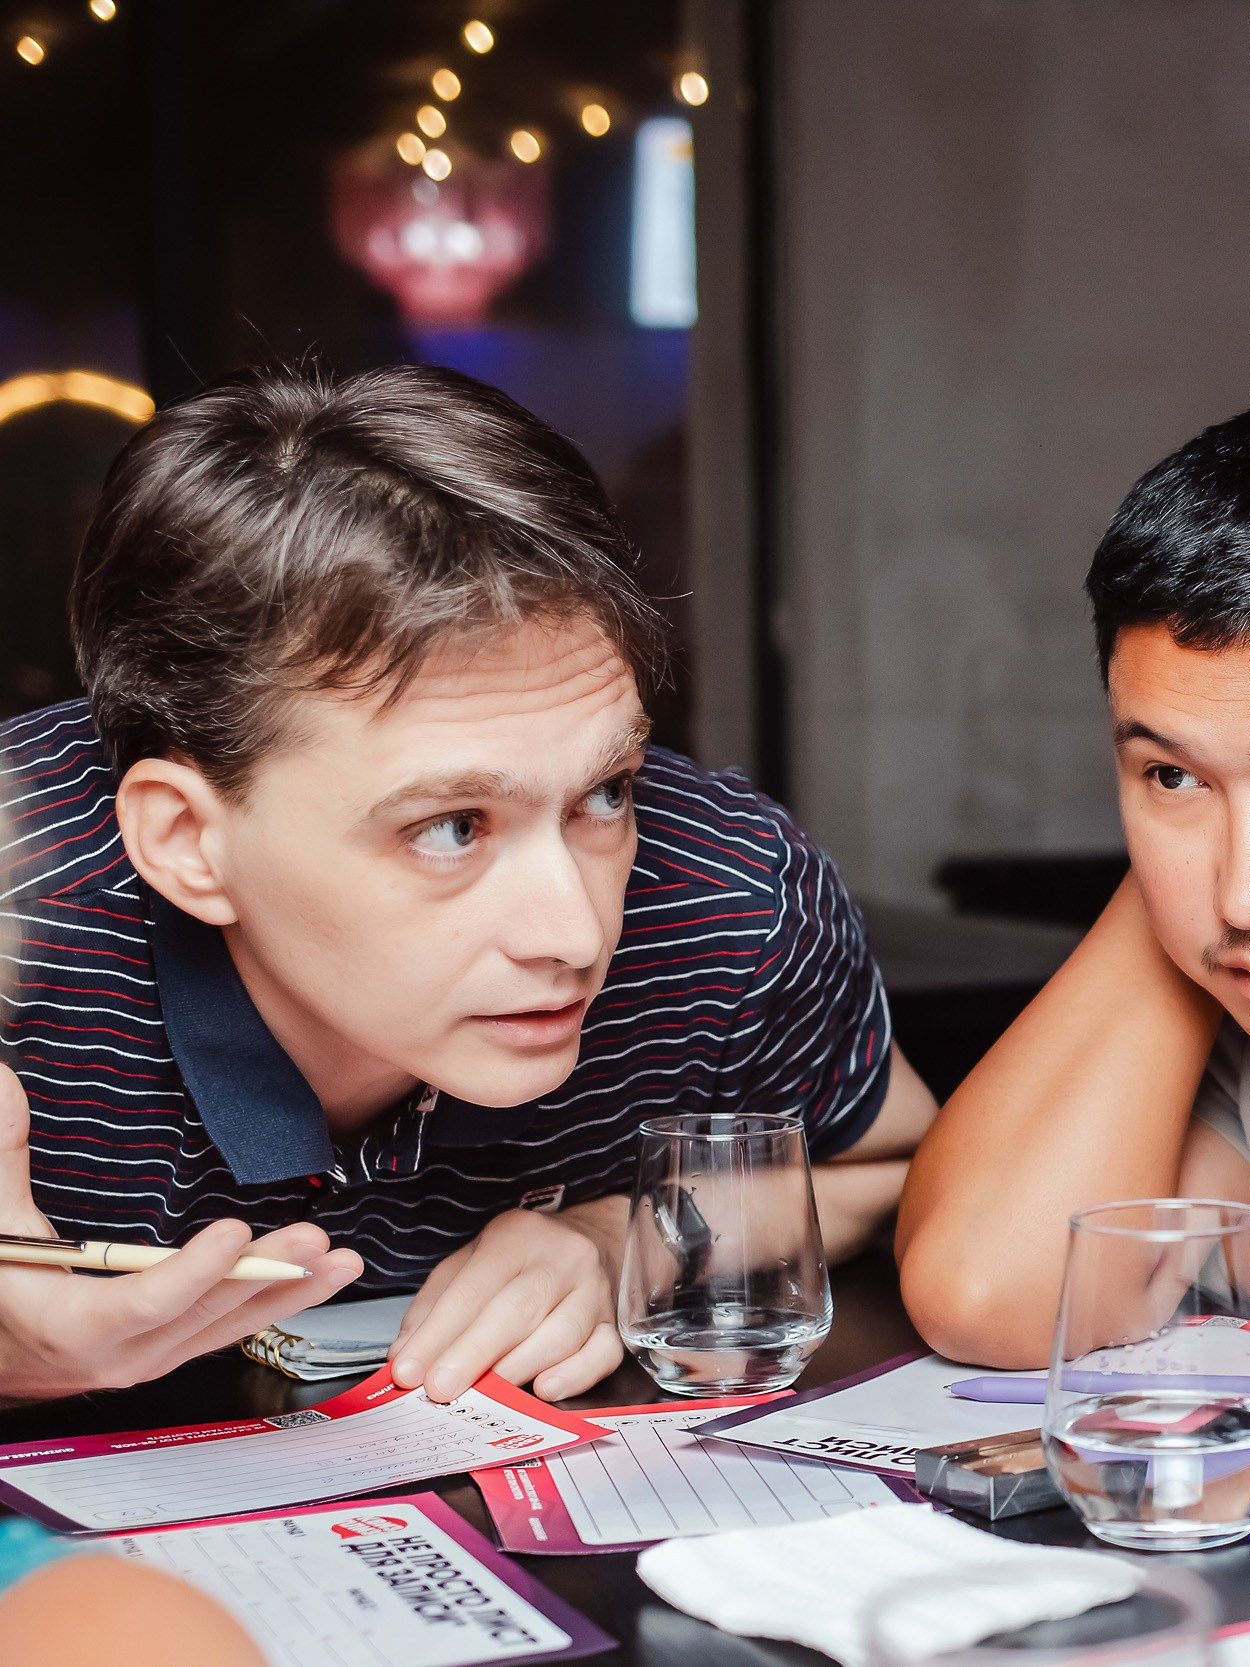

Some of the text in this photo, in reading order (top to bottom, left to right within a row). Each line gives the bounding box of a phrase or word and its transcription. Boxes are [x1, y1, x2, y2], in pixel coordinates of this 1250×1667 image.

[773, 1438, 887, 1460] ЛИСТ
[340, 1540, 403, 1568] ДЛЯ
[388, 1535, 433, 1552] НЕ
[406, 1553, 492, 1607] ПРОСТО
